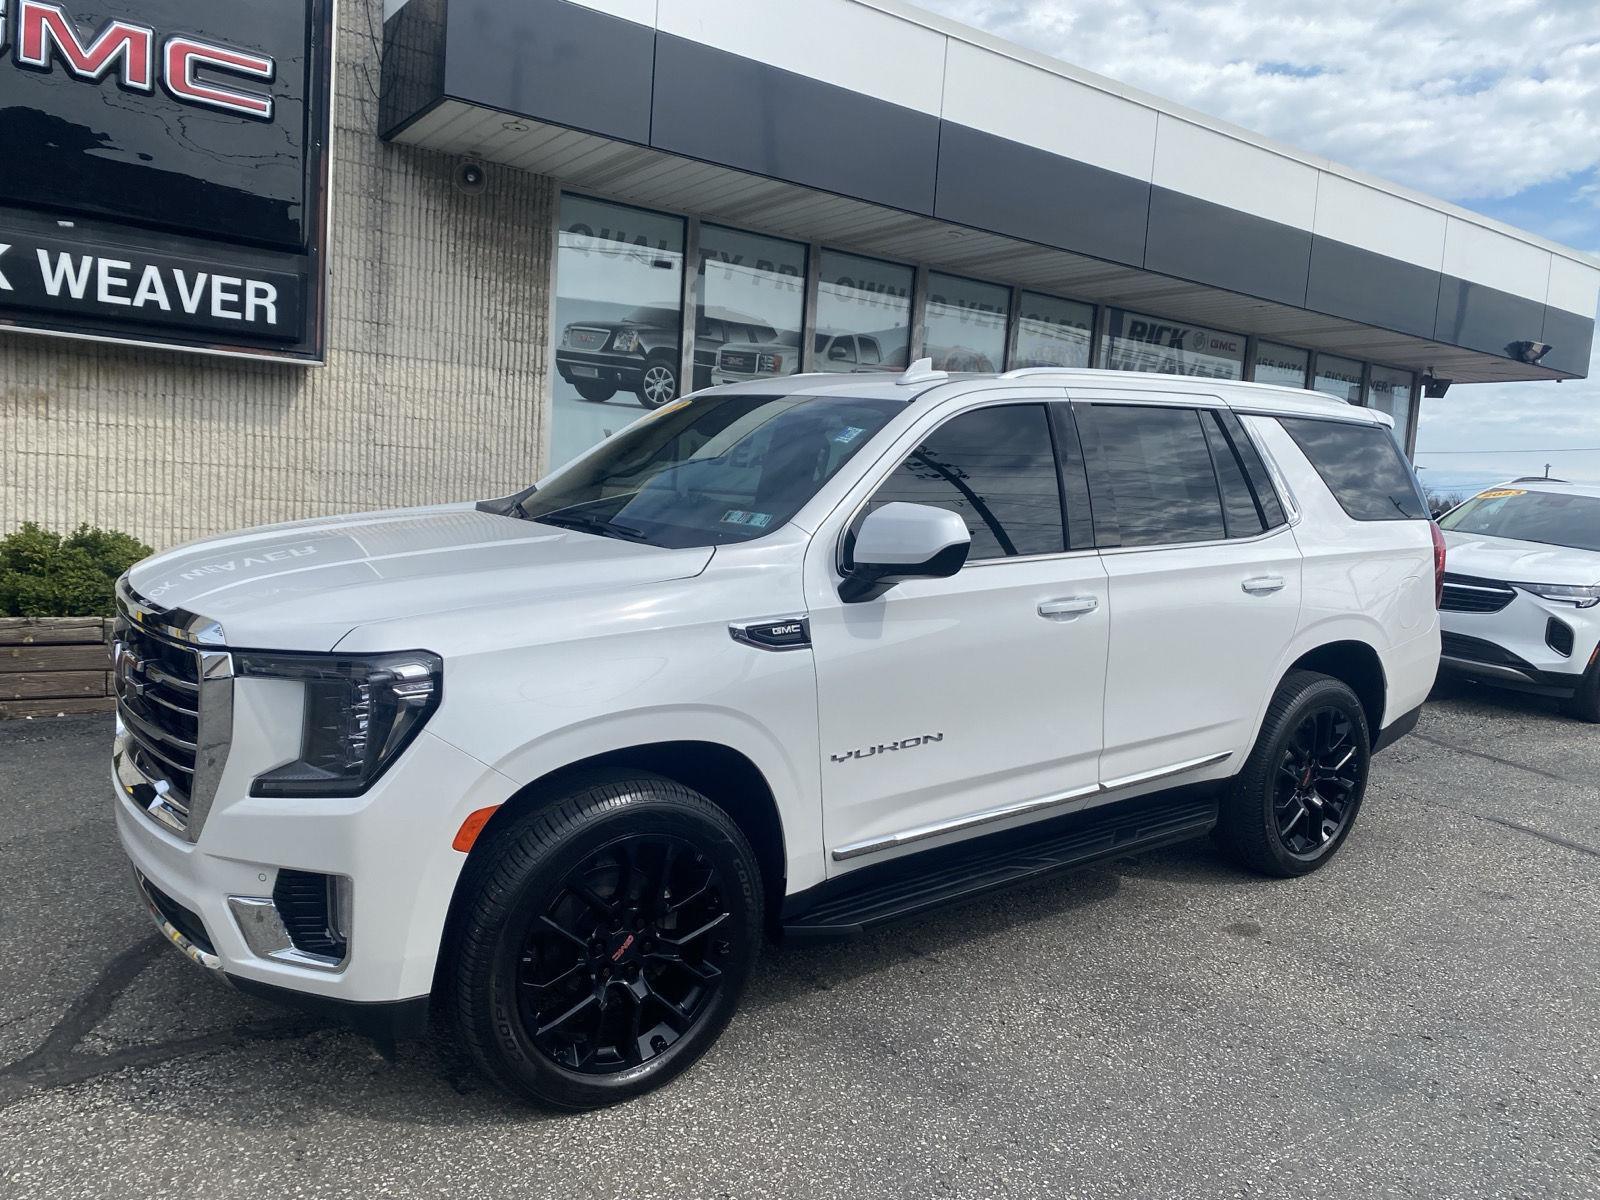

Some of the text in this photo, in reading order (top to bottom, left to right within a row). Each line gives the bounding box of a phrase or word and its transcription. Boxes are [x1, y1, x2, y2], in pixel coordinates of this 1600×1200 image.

[0, 0, 274, 120] MC
[36, 247, 278, 325] WEAVER
[567, 222, 744, 281] QUALTY
[834, 275, 947, 320] OWND
[1126, 318, 1191, 361] RICK
[1210, 338, 1238, 353] GMC
[772, 624, 801, 635] GMC
[830, 732, 944, 763] YUKON
